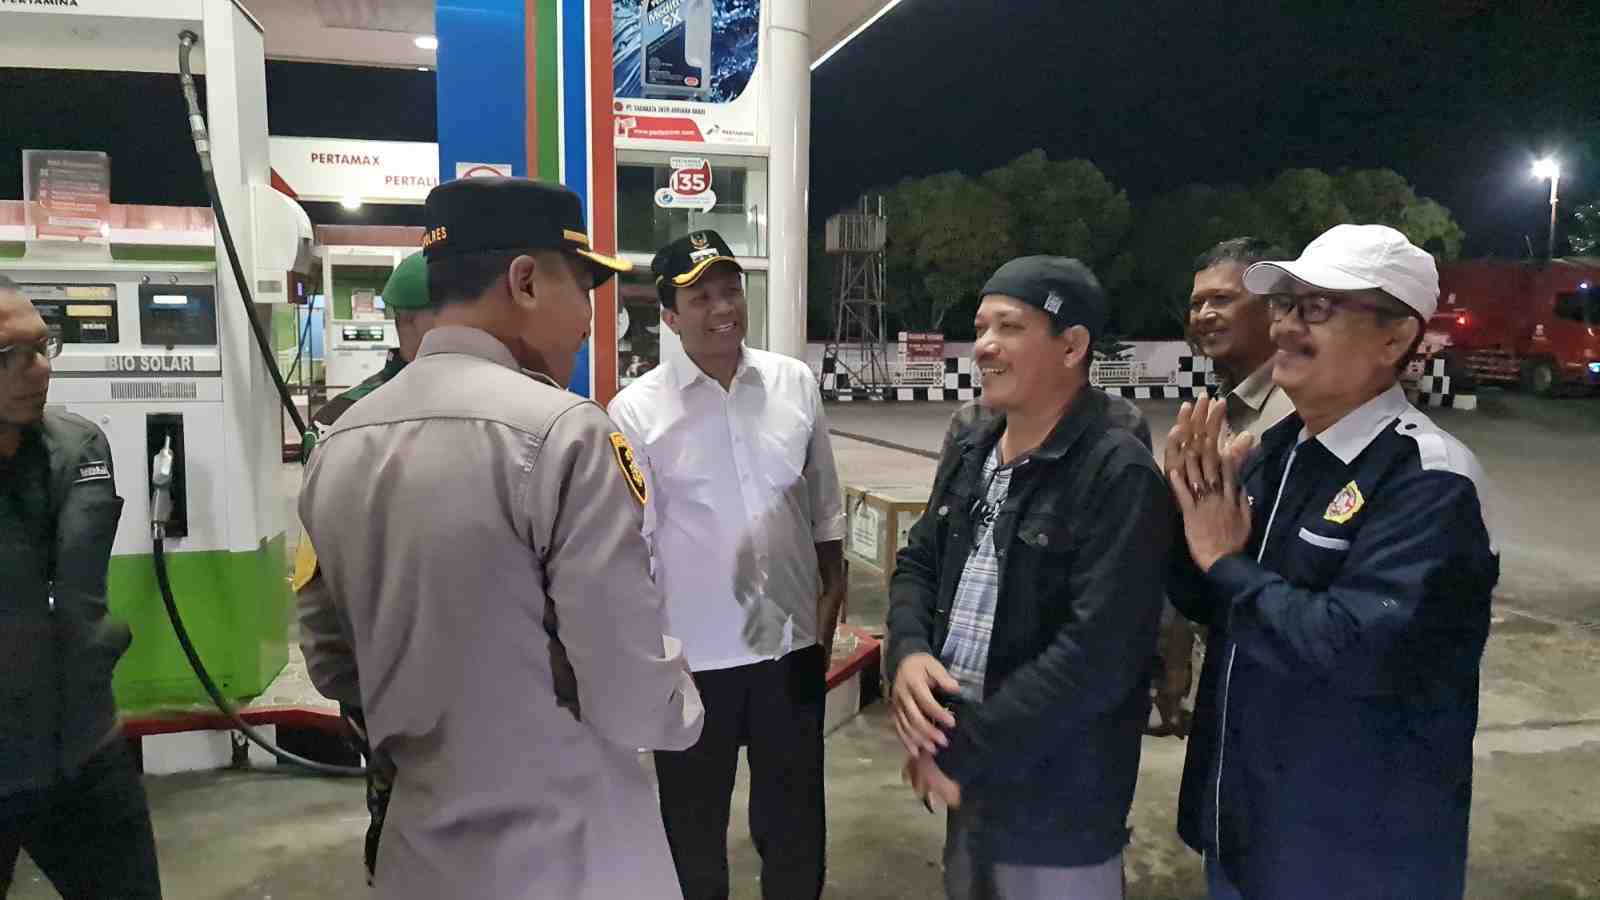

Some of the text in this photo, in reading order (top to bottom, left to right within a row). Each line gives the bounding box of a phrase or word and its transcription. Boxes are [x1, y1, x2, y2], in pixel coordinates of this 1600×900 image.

[310, 152, 380, 166] PERTAMAX
[672, 173, 706, 192] 135
[140, 355, 191, 371] SOLAR
